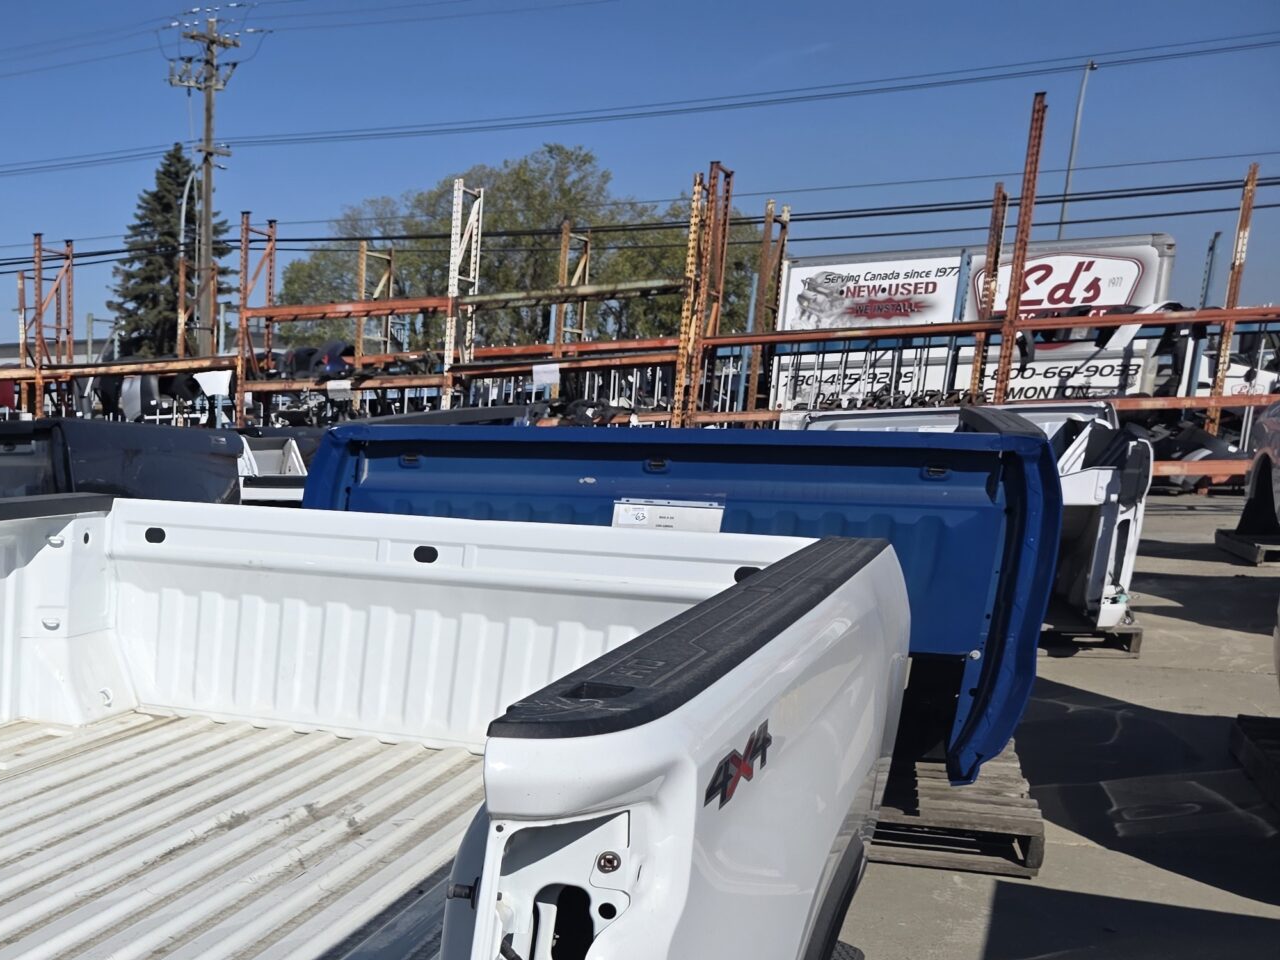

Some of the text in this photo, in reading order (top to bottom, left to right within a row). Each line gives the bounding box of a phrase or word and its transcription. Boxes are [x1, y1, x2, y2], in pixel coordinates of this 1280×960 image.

[824, 266, 960, 285] Serving Canada since 1977
[1006, 260, 1102, 306] Ed's
[845, 281, 938, 298] NEW USED
[983, 385, 1090, 402] EMONTON
